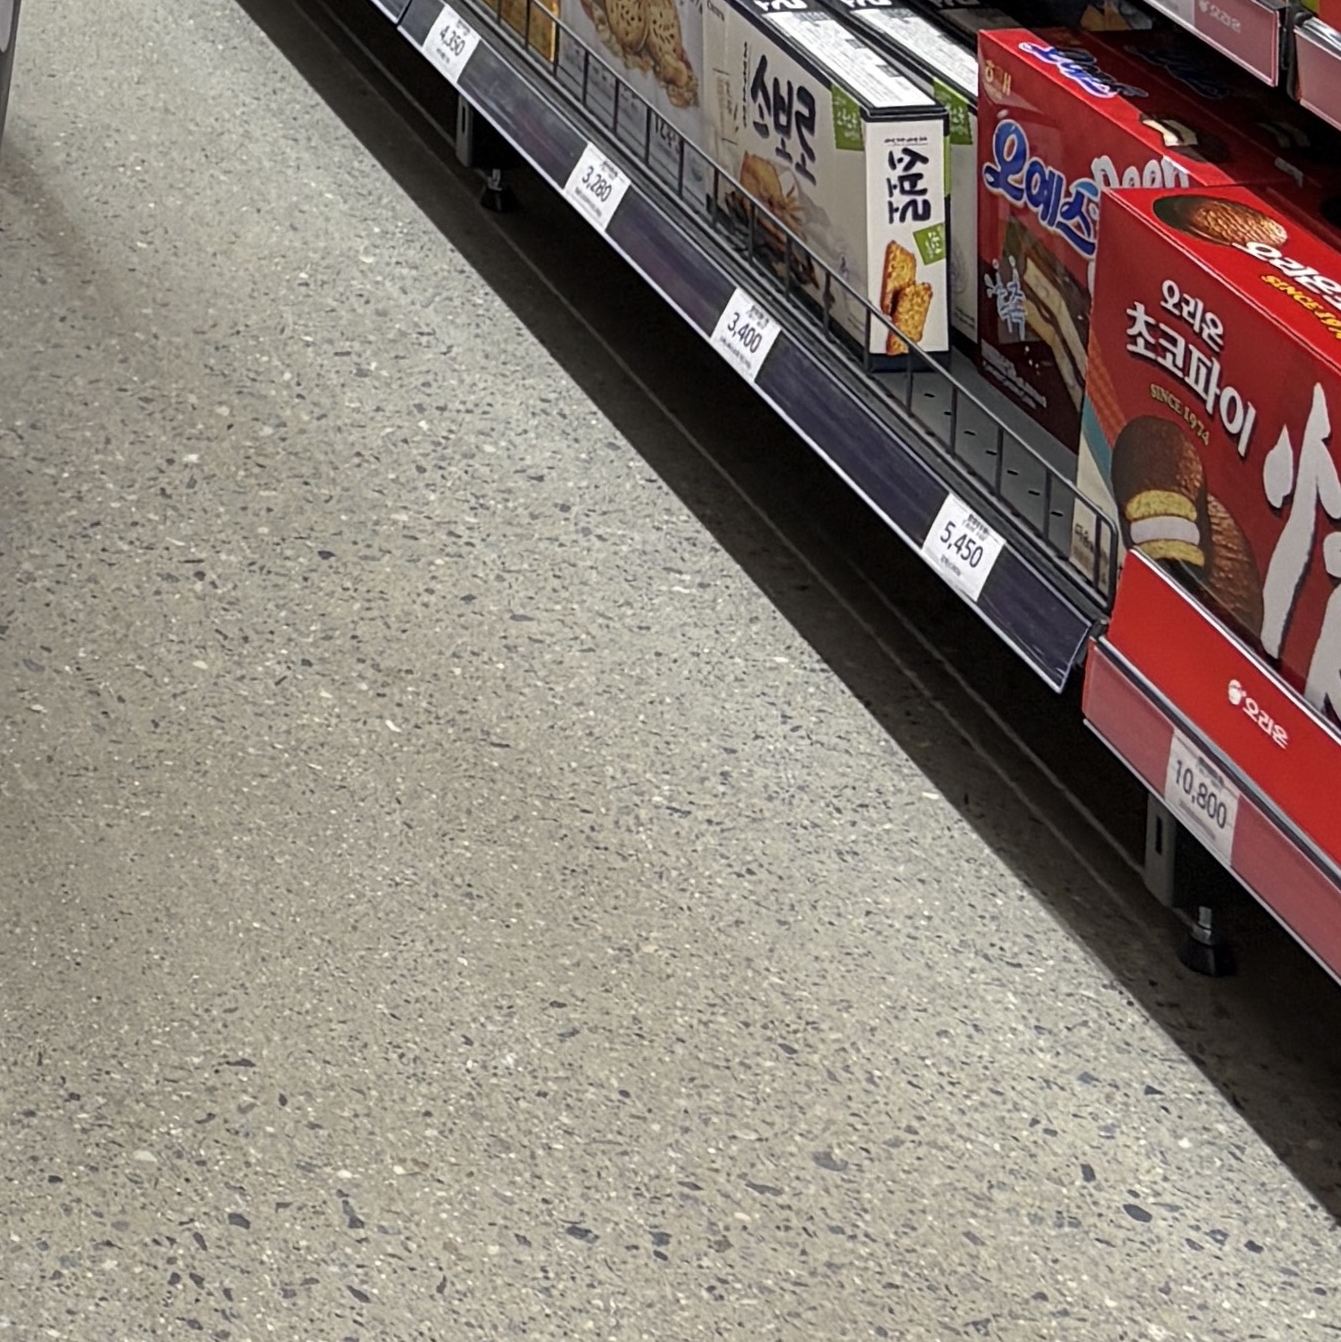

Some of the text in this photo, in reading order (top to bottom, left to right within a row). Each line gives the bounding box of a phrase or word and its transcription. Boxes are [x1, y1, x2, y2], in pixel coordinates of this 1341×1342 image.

[439, 25, 467, 59] 4,350
[750, 53, 818, 186] 소보로
[581, 167, 612, 204] 3,280
[886, 146, 932, 225] 소보로
[984, 117, 1101, 258] 오예스
[724, 311, 764, 356] 3,400
[1161, 279, 1226, 349] 오리온
[1125, 300, 1258, 458] 초코파이
[1149, 381, 1211, 448] SINCE 1974
[936, 519, 986, 570] 5,450
[1240, 690, 1289, 750] 오리온
[1171, 754, 1229, 832] 10,800
